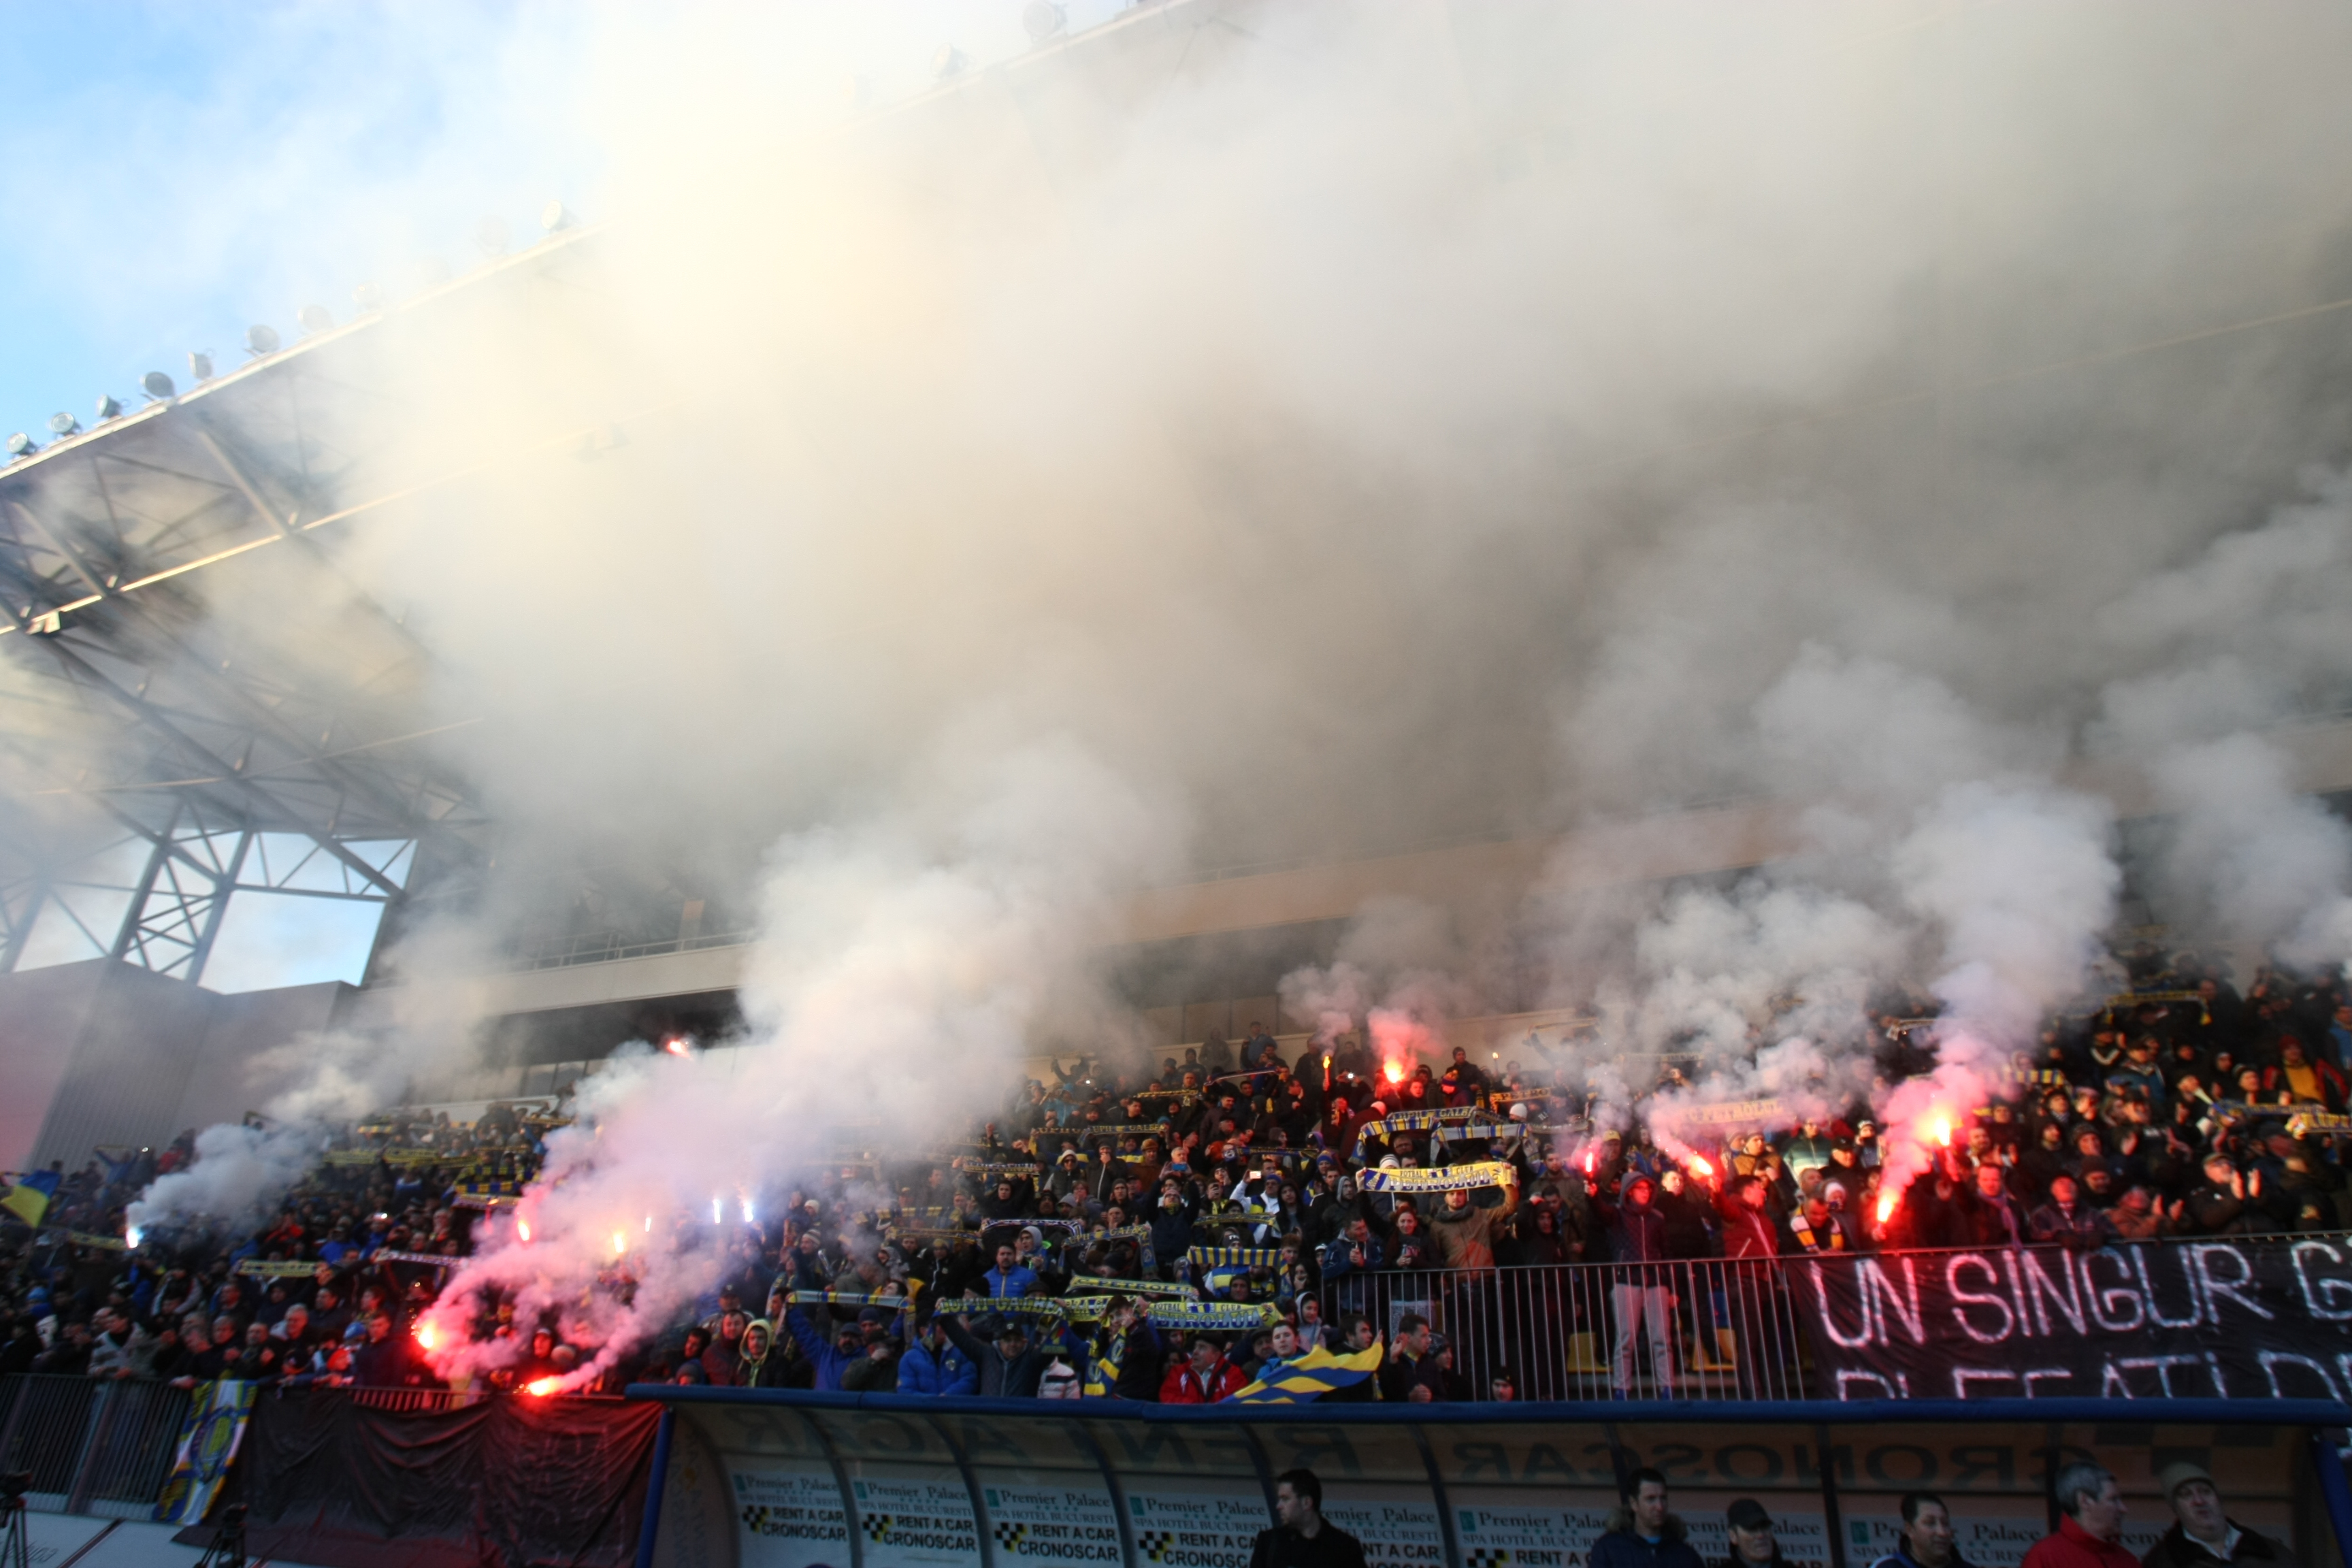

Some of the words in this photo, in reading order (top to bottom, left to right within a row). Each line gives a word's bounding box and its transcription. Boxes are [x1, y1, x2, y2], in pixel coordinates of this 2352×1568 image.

[1388, 1169, 1490, 1191] PETROLUL
[1400, 1170, 1423, 1178] FOTBAL
[1456, 1166, 1473, 1175] CLUB
[1098, 1279, 1190, 1294] PETROLU
[1809, 1257, 1925, 1348] UN
[1945, 1243, 2275, 1343] SINGUR
[1220, 1303, 1241, 1311] CLUB
[746, 1475, 793, 1490] Premier
[800, 1477, 838, 1492] Palace
[868, 1483, 919, 1497] Premier
[927, 1486, 968, 1501] Palace
[1000, 1490, 1057, 1505] Premier
[1065, 1492, 1111, 1507] Palace
[1145, 1498, 1207, 1514] Premier
[1216, 1501, 1266, 1516] Palace
[773, 1507, 804, 1520] RENT
[808, 1509, 817, 1521] A
[818, 1509, 845, 1523] CAR
[878, 1503, 911, 1512] HOTEL
[914, 1504, 973, 1517] BUCURESTI
[990, 1509, 1010, 1519] SPA
[1011, 1510, 1047, 1521] HOTEL
[1050, 1512, 1115, 1524] BUCURESTI
[1324, 1507, 1372, 1521] emier
[1382, 1508, 1435, 1523] Palace
[896, 1515, 930, 1529] RENT
[934, 1518, 943, 1531] A
[945, 1518, 974, 1533] CAR
[1134, 1517, 1155, 1528] SPA
[1157, 1518, 1198, 1530] HOTEL
[1199, 1520, 1269, 1533] BUCURESTI
[1478, 1512, 1551, 1528] Premier
[1562, 1513, 1607, 1529] Palac
[1773, 1518, 1820, 1535] alace
[762, 1522, 847, 1542] CRONOSCAR
[1032, 1524, 1068, 1538] RENT
[1073, 1526, 1084, 1539] A
[1088, 1526, 1117, 1542] CAR
[1362, 1529, 1439, 1542] BUCURESTI
[1973, 1522, 2041, 1541] Palace
[883, 1531, 977, 1552] CRONOSCAR
[1179, 1533, 1218, 1548] RENT
[1224, 1535, 1235, 1549] A
[1238, 1536, 1257, 1550] CA
[1463, 1533, 1488, 1545] SPA
[1491, 1534, 1535, 1547] HOTEL
[1540, 1536, 1595, 1548] BUCUR
[1017, 1541, 1120, 1563] CRONOSCAR
[1362, 1544, 1382, 1556] NT
[1389, 1544, 1400, 1558] A
[1403, 1545, 1440, 1559] CAR
[1515, 1550, 1563, 1566] RENT
[1568, 1552, 1581, 1567] A
[1780, 1544, 1823, 1556] RESTI
[1163, 1550, 1247, 1568] CRONOSC
